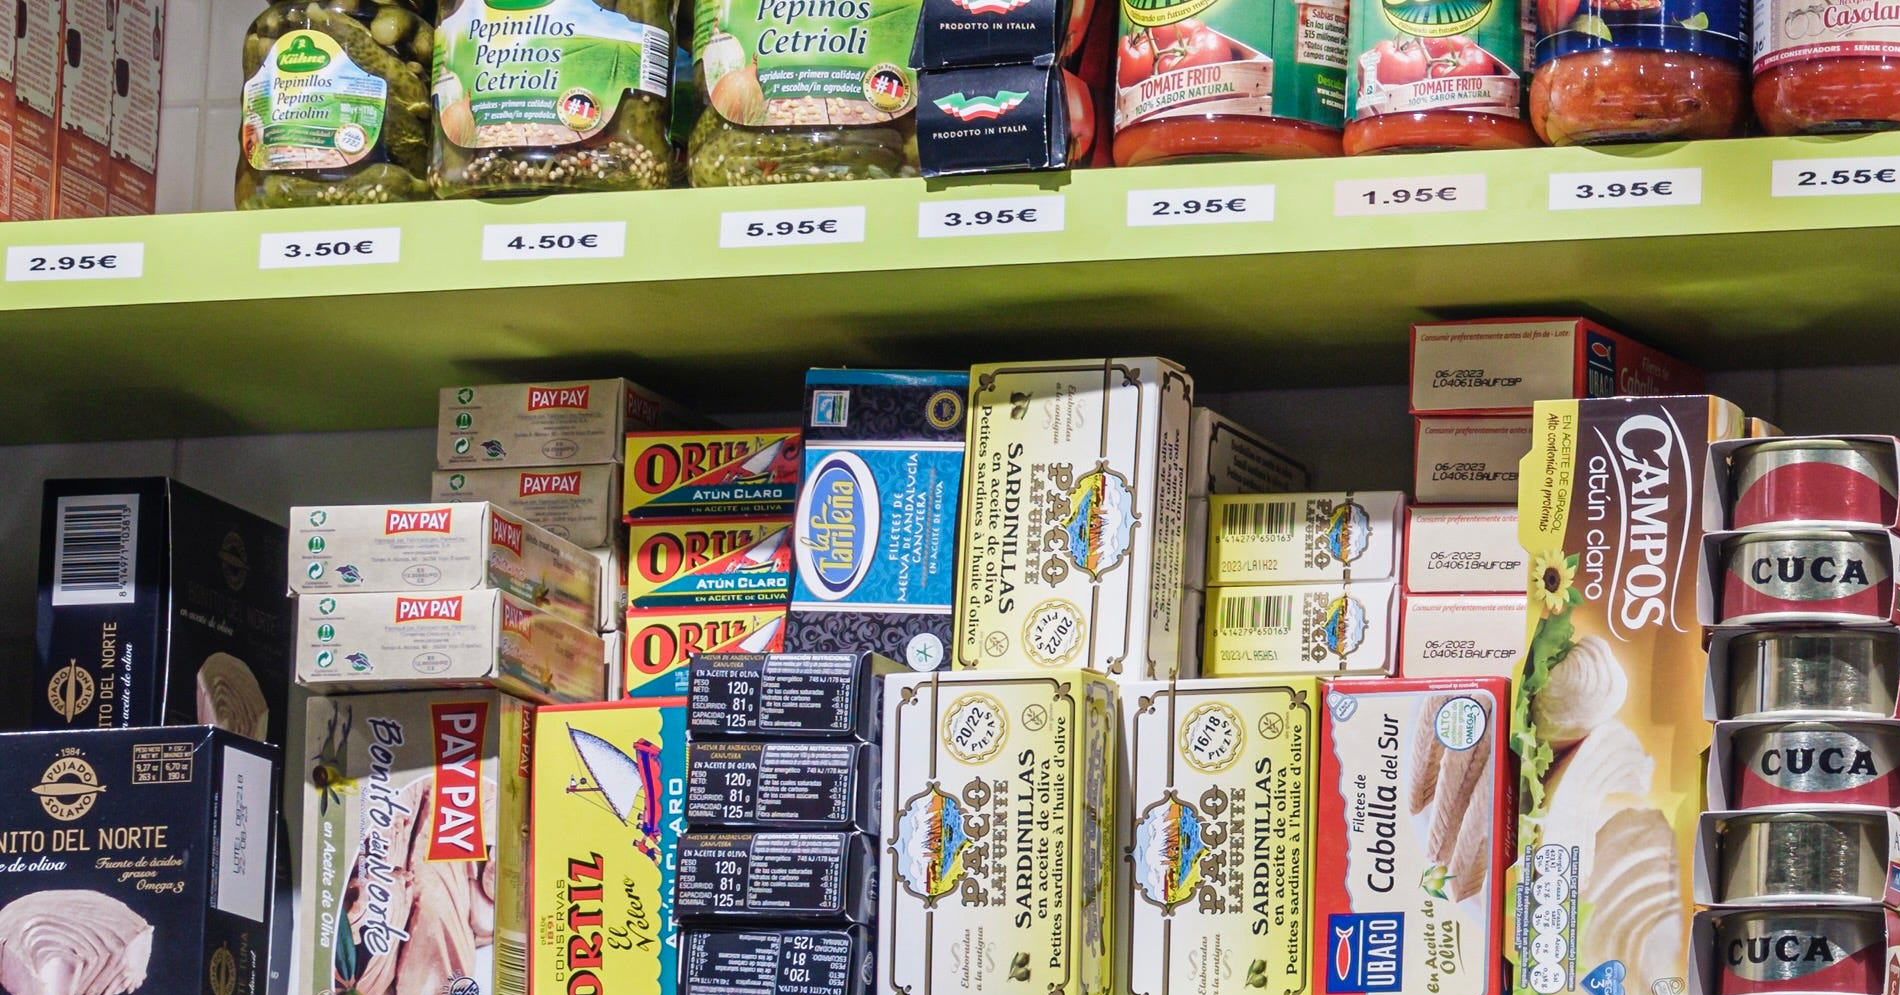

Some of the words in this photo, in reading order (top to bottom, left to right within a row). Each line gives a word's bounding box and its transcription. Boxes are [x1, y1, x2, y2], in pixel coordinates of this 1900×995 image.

[469, 18, 575, 40] Pepinillos
[280, 53, 326, 65] Kühne
[475, 43, 560, 67] Pepinos
[274, 75, 332, 90] Pepinillos
[474, 69, 559, 91] Cetrioli
[1140, 73, 1185, 99] TOMATE
[1188, 66, 1221, 87] FRITO
[277, 92, 324, 105] Pepinos
[568, 101, 590, 118] #1
[1135, 99, 1154, 116] 100%
[1156, 92, 1186, 108] SABOR
[1189, 83, 1235, 99] NATURAL
[271, 106, 329, 121] Cetriolini
[1797, 167, 1897, 187] 2.55€
[1361, 185, 1459, 206] 1.95€
[1575, 179, 1674, 200] 3.95€
[943, 207, 1039, 228] 3.95€
[1151, 197, 1248, 217] 2.95€
[745, 218, 839, 238] 5.95€
[283, 239, 374, 259] 3.50€
[506, 233, 599, 251] 4.50€
[28, 252, 119, 273] 2.95€
[1586, 455, 1612, 527] atún
[389, 511, 418, 530] PAY
[421, 511, 450, 530] PAY
[1616, 413, 1672, 634] CAMPOS
[637, 531, 752, 583] ORTIZ
[1430, 552, 1481, 562] 06/2023
[1585, 531, 1611, 600] claro
[696, 575, 736, 589] ATÚN
[739, 576, 787, 588] CLARO
[1751, 557, 1869, 585] CUCA
[728, 682, 748, 694] 120
[1387, 713, 1399, 750] Sur
[61, 748, 80, 756] 1984
[440, 713, 476, 778] PAY
[46, 760, 93, 782] PUJADO
[1386, 754, 1398, 780] del
[1761, 748, 1878, 777] CUCA
[44, 795, 91, 818] SOLANO
[440, 784, 474, 853] PAY
[1016, 749, 1037, 930] SARDINILLAS
[1368, 785, 1397, 893] Caballa
[1367, 919, 1397, 986] UBAGO
